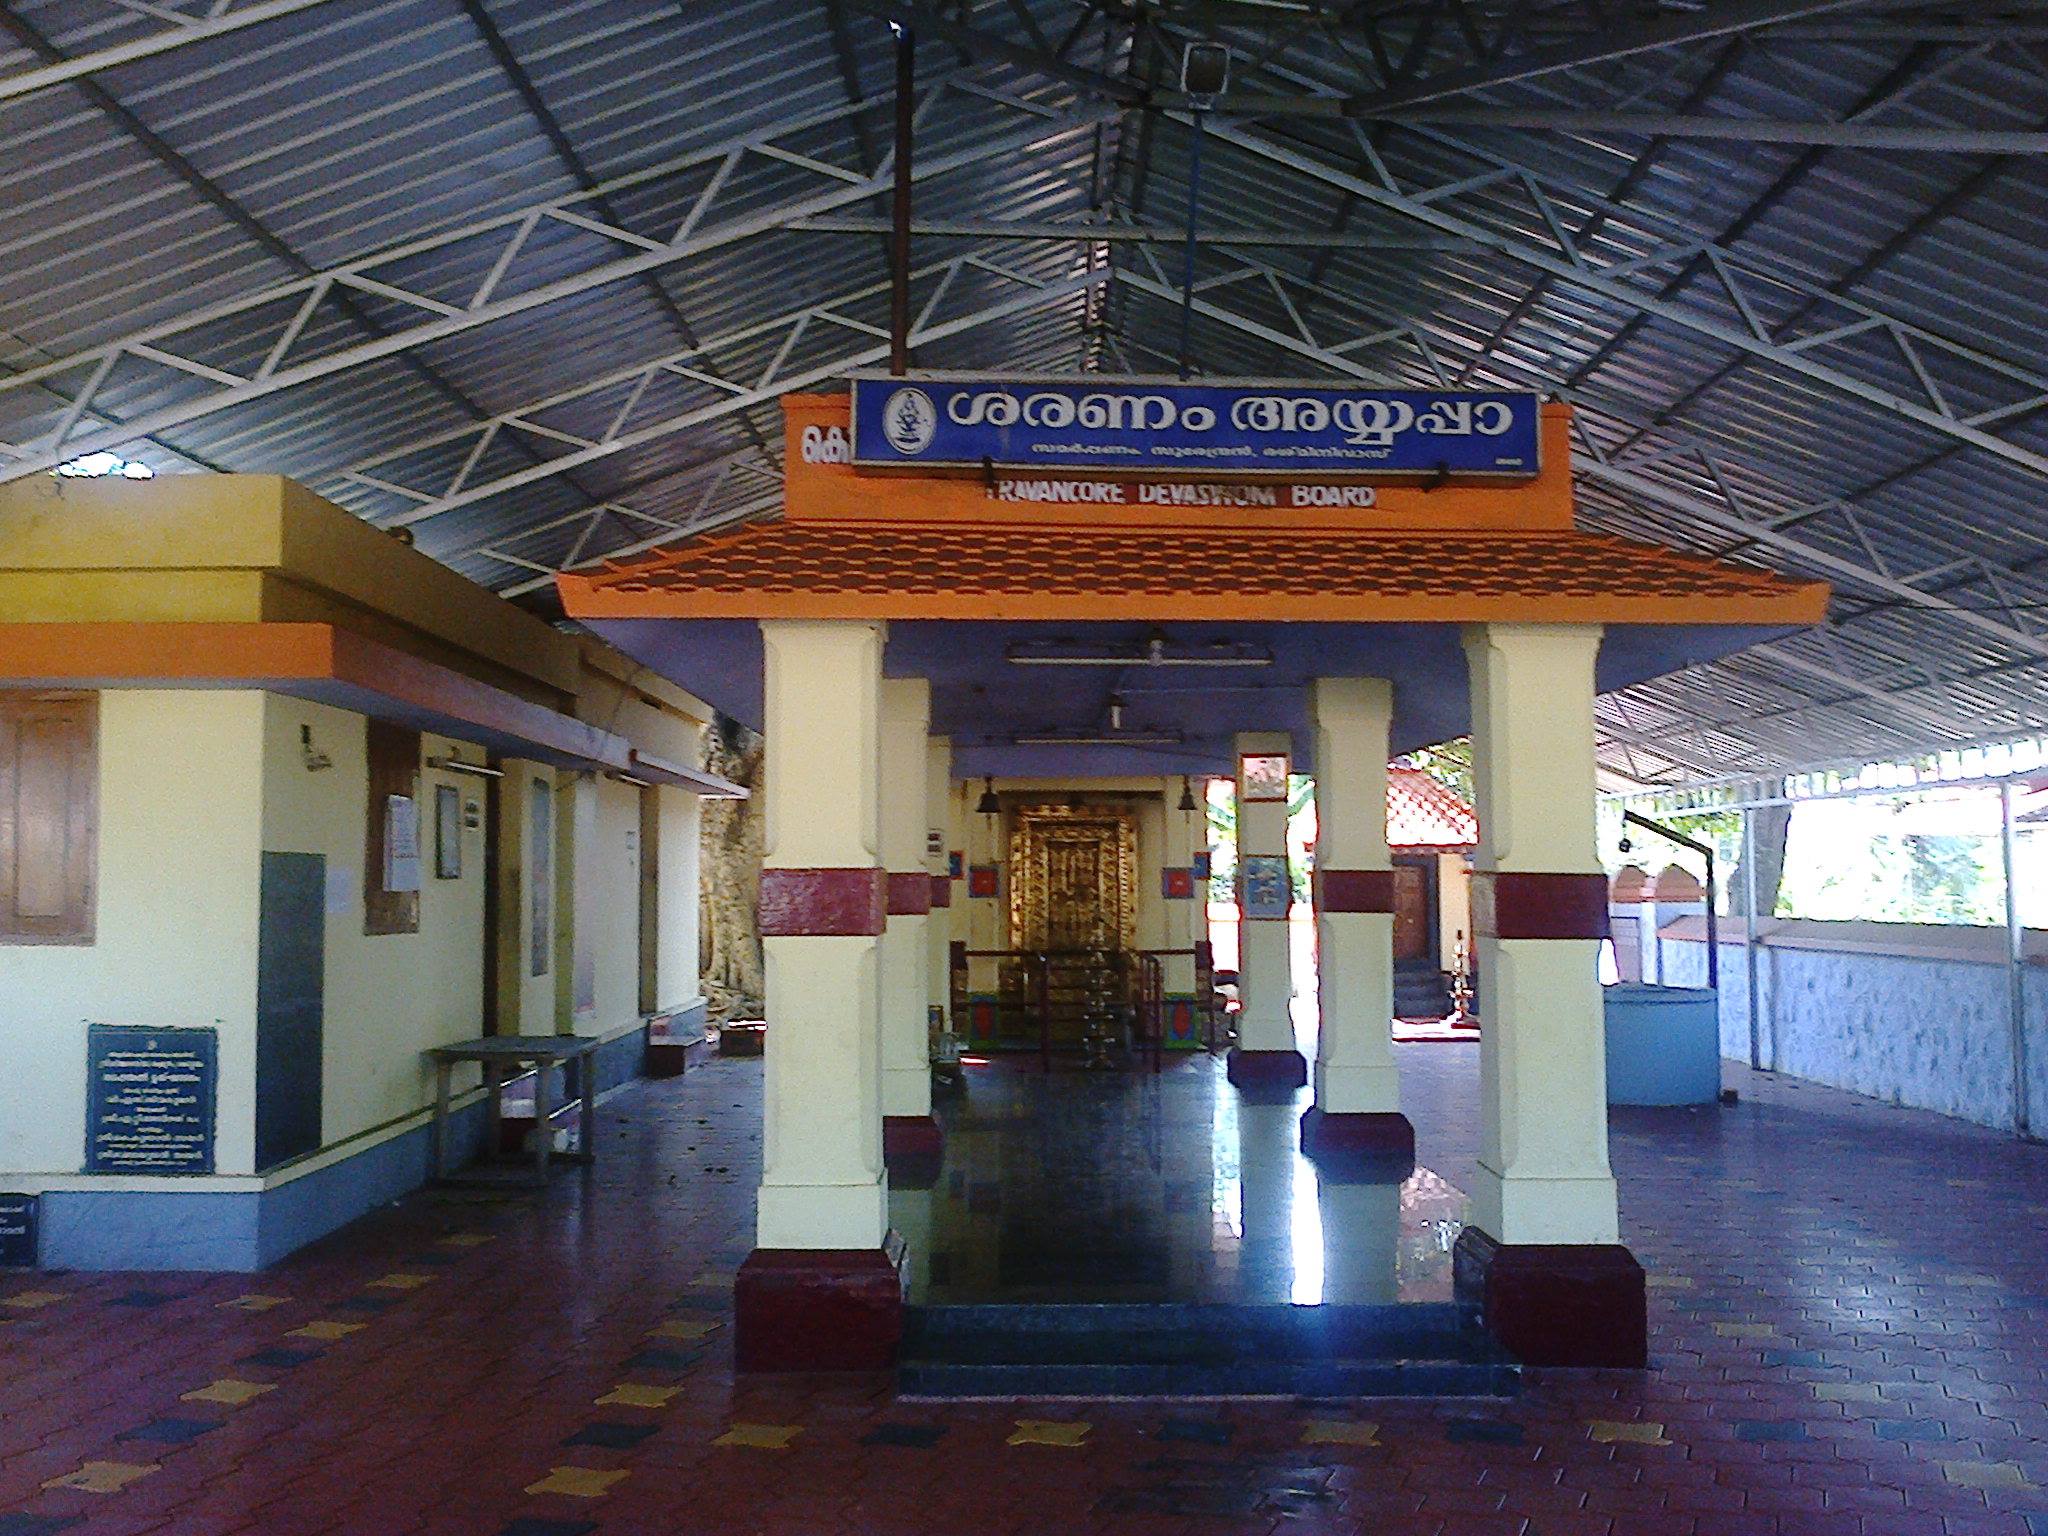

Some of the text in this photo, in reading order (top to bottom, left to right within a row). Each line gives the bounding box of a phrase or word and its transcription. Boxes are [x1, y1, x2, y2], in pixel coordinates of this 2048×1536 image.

[947, 391, 1514, 446] ശരണം അയ്യപ്പാ
[1291, 485, 1377, 508] BOARD
